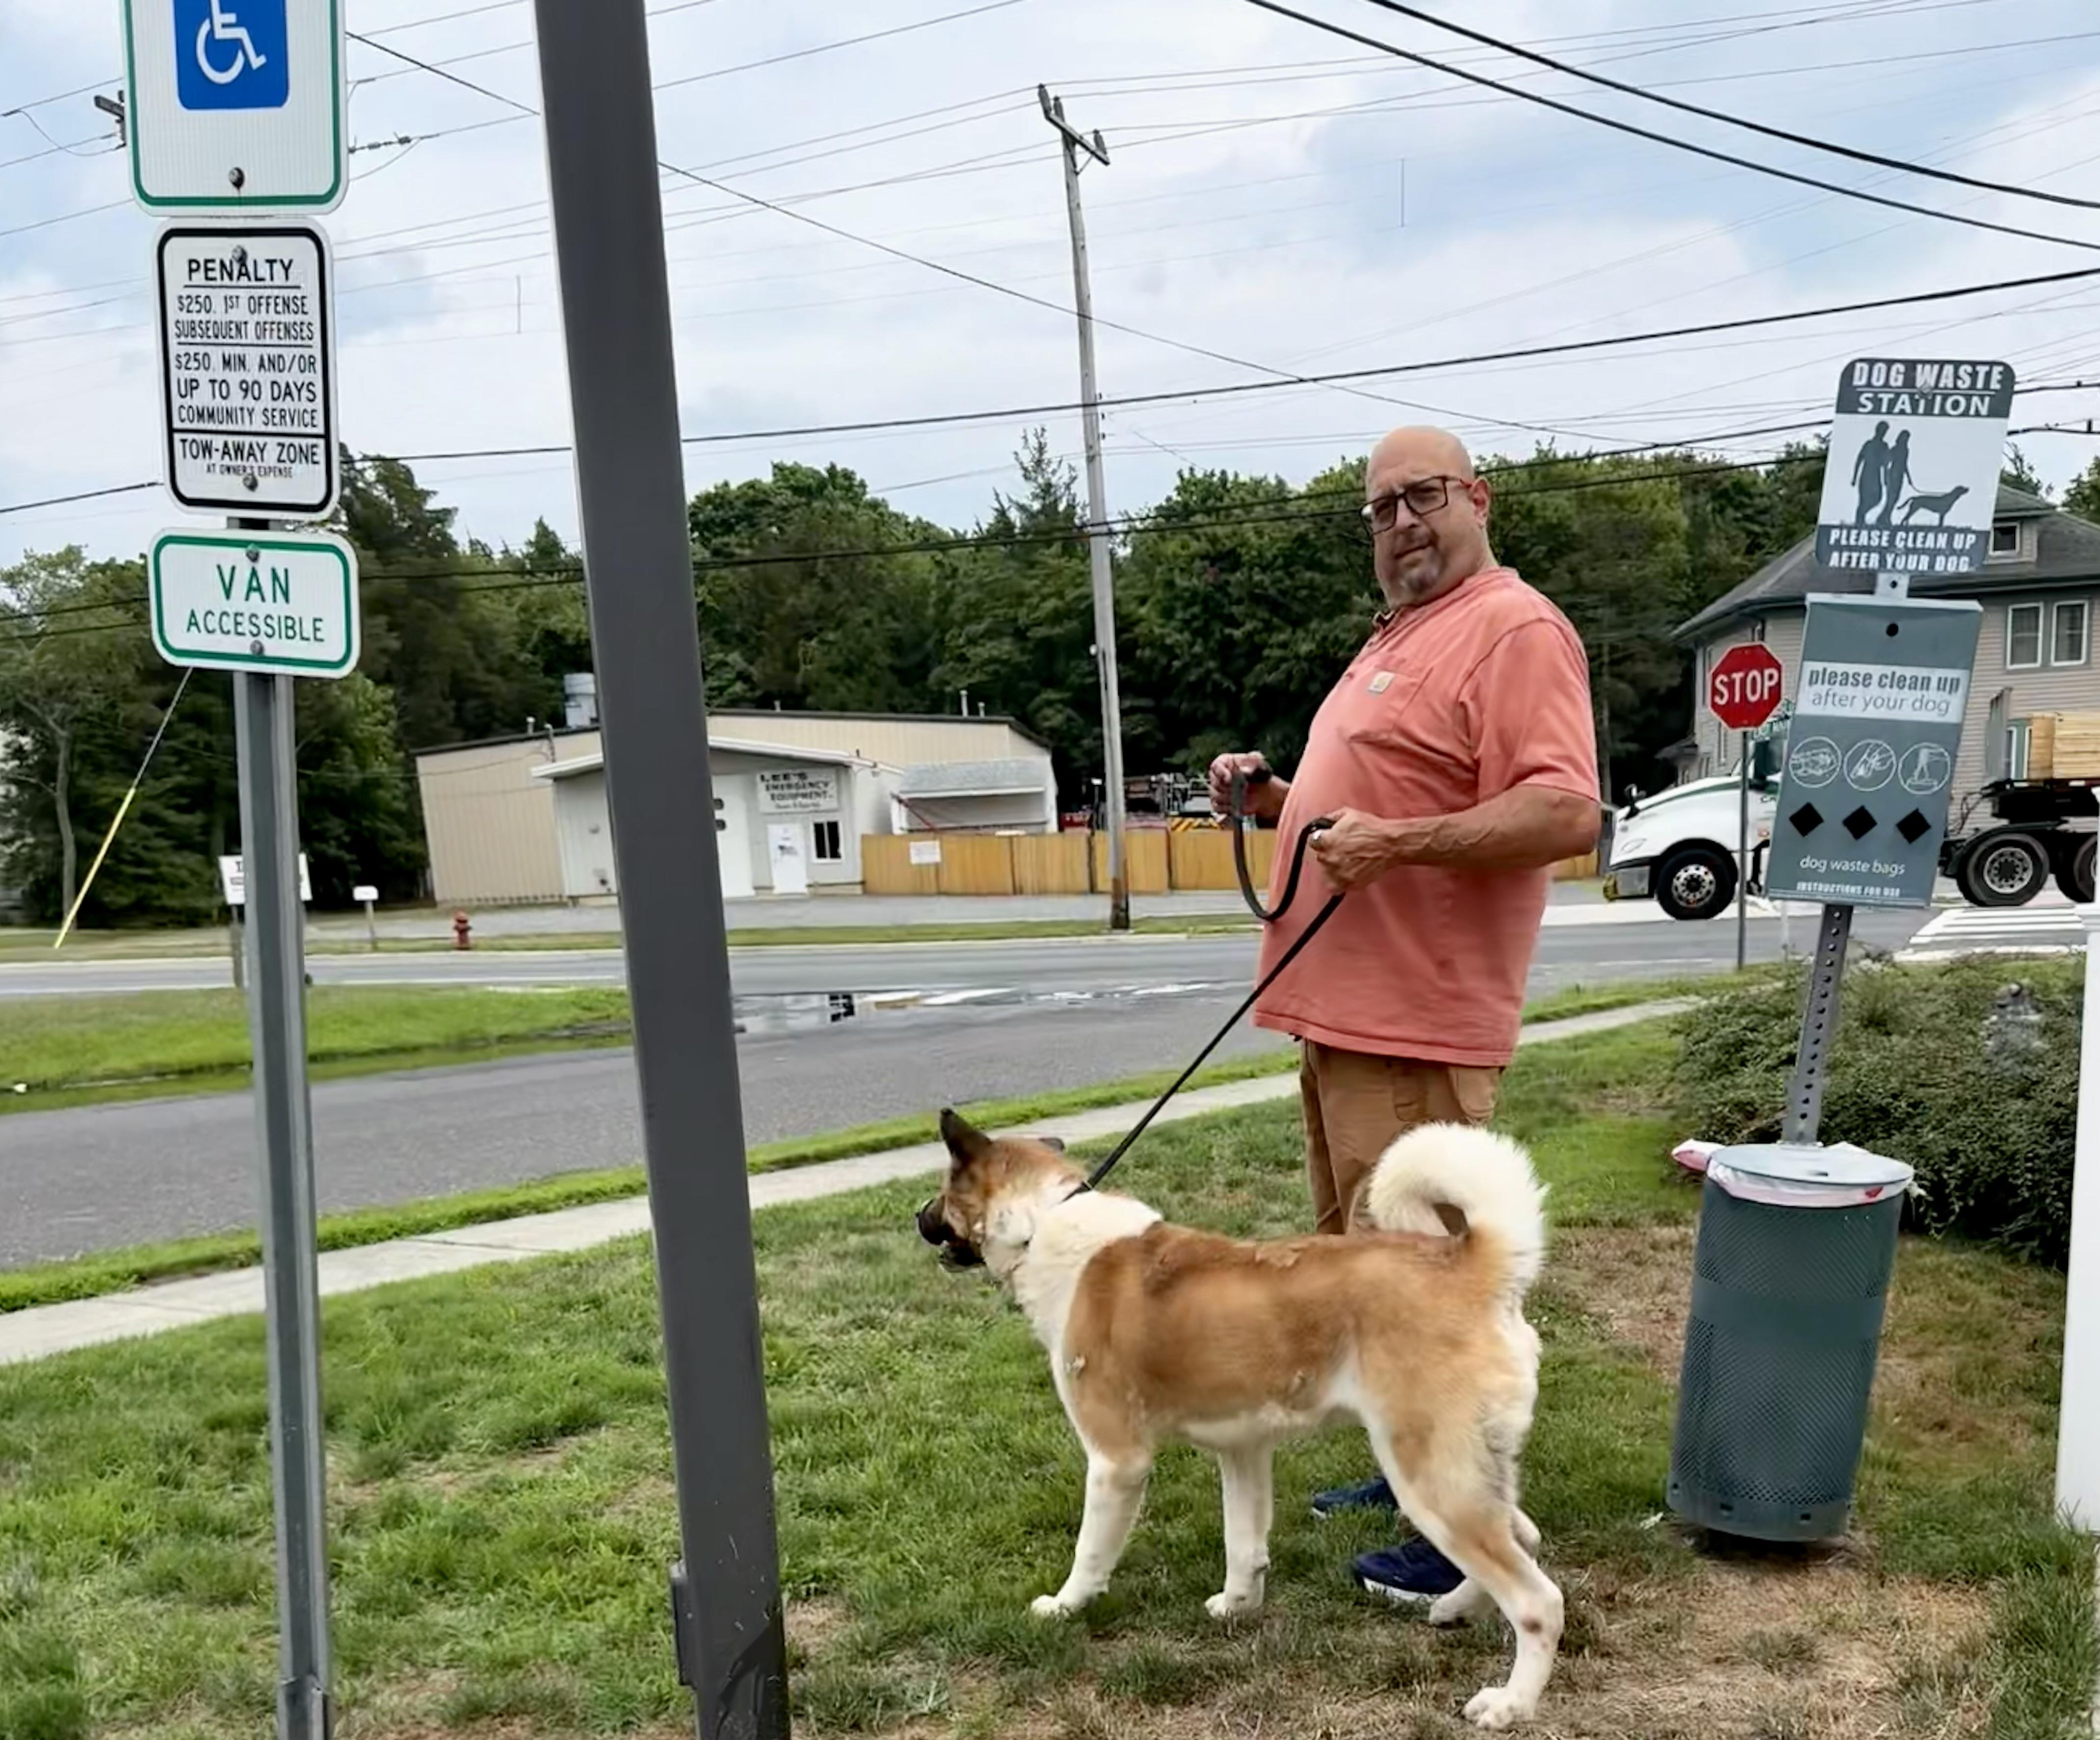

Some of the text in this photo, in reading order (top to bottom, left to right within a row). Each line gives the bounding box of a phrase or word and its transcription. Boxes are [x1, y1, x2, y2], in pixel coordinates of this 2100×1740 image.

[187, 259, 293, 282] PENALTY
[248, 295, 309, 315] OFFENSE
[175, 320, 314, 340] SUBSEQUENT OFFENSES
[259, 354, 316, 374] AND/OR
[1852, 362, 2003, 390] DOG WASTE
[177, 378, 317, 402] UP TO 90 DAYS
[178, 405, 318, 427] COMMUNITY SERVICE
[1858, 393, 1991, 416] STATION
[180, 439, 320, 464] TOW-AWAY ZONE
[207, 463, 216, 473] AT
[1829, 528, 1976, 550] PLEASE CLEAN UP
[1829, 551, 1970, 573] AFTER YOUR DOG
[217, 564, 290, 604] VAN
[186, 609, 325, 642] ACCESSIBLE
[1713, 667, 1779, 705] STOP
[1809, 668, 1960, 695] please clean up
[1811, 688, 1856, 709] after
[1863, 695, 1907, 712] your
[1911, 694, 1950, 717] dog
[1799, 855, 1905, 878] dog waste bags
